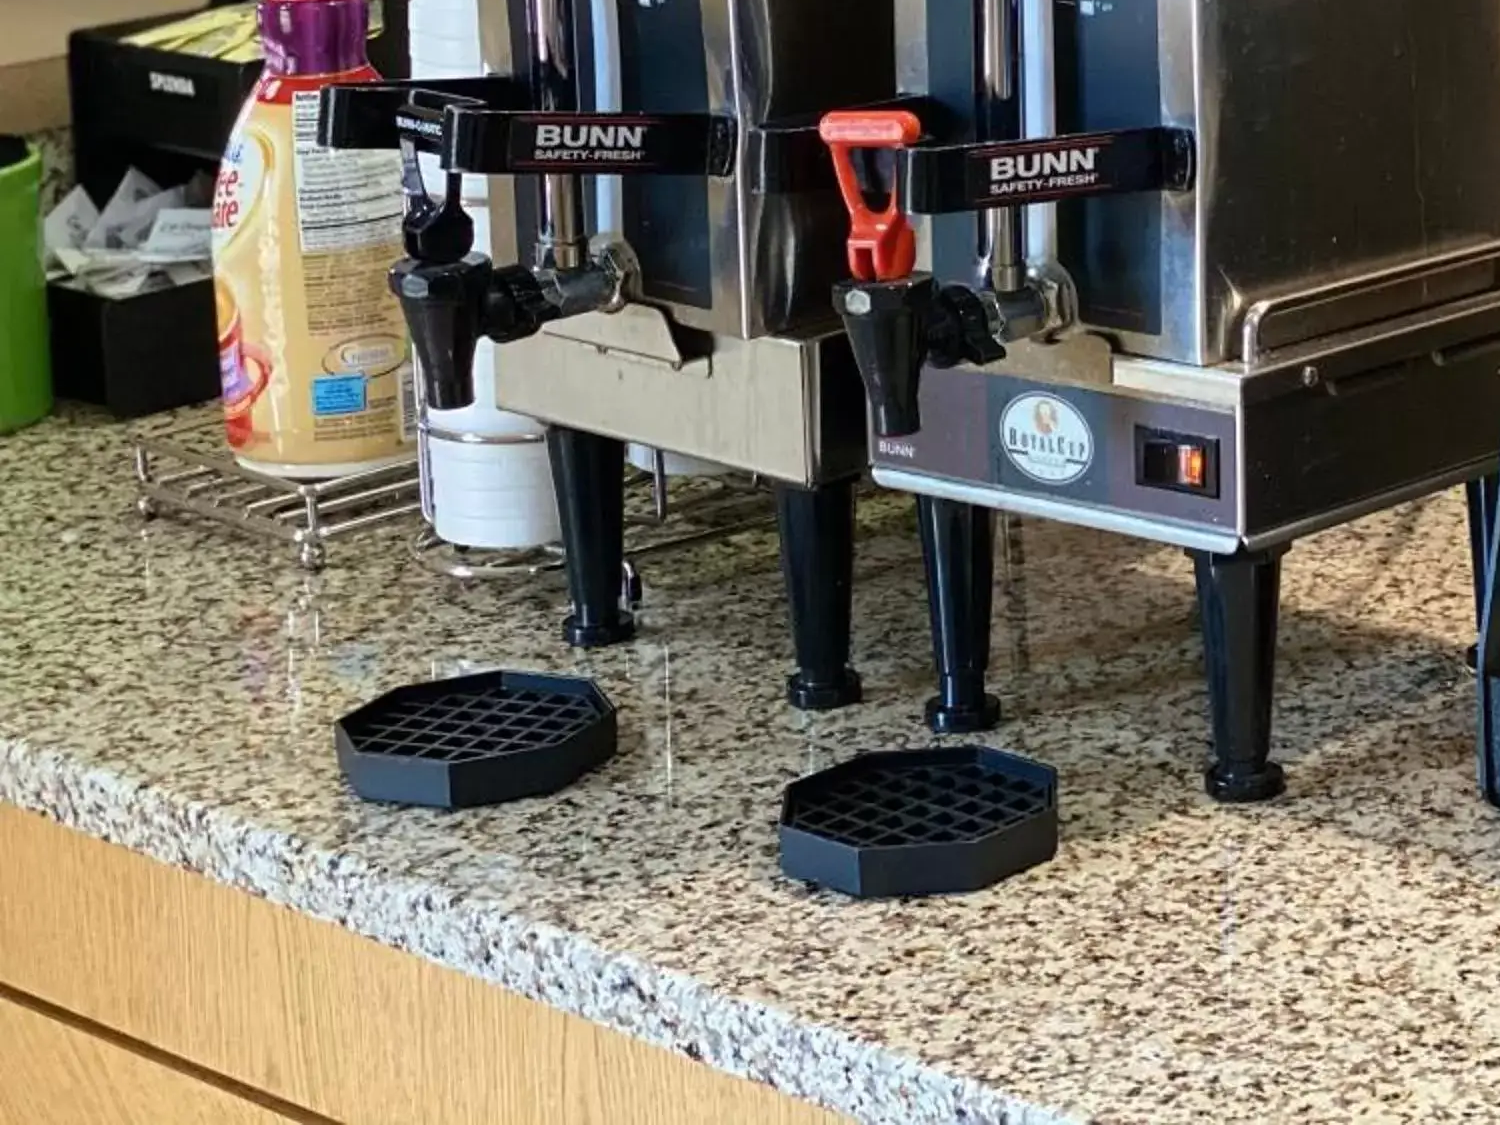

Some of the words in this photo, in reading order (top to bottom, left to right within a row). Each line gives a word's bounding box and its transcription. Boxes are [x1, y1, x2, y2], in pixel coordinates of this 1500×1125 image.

[149, 71, 195, 96] SPLENDA
[535, 124, 643, 148] BUNN
[533, 149, 644, 161] SAFETY-FRESH
[990, 148, 1097, 181] BUNN
[989, 173, 1097, 195] SAFETY-FRESH
[879, 440, 914, 459] BUNN
